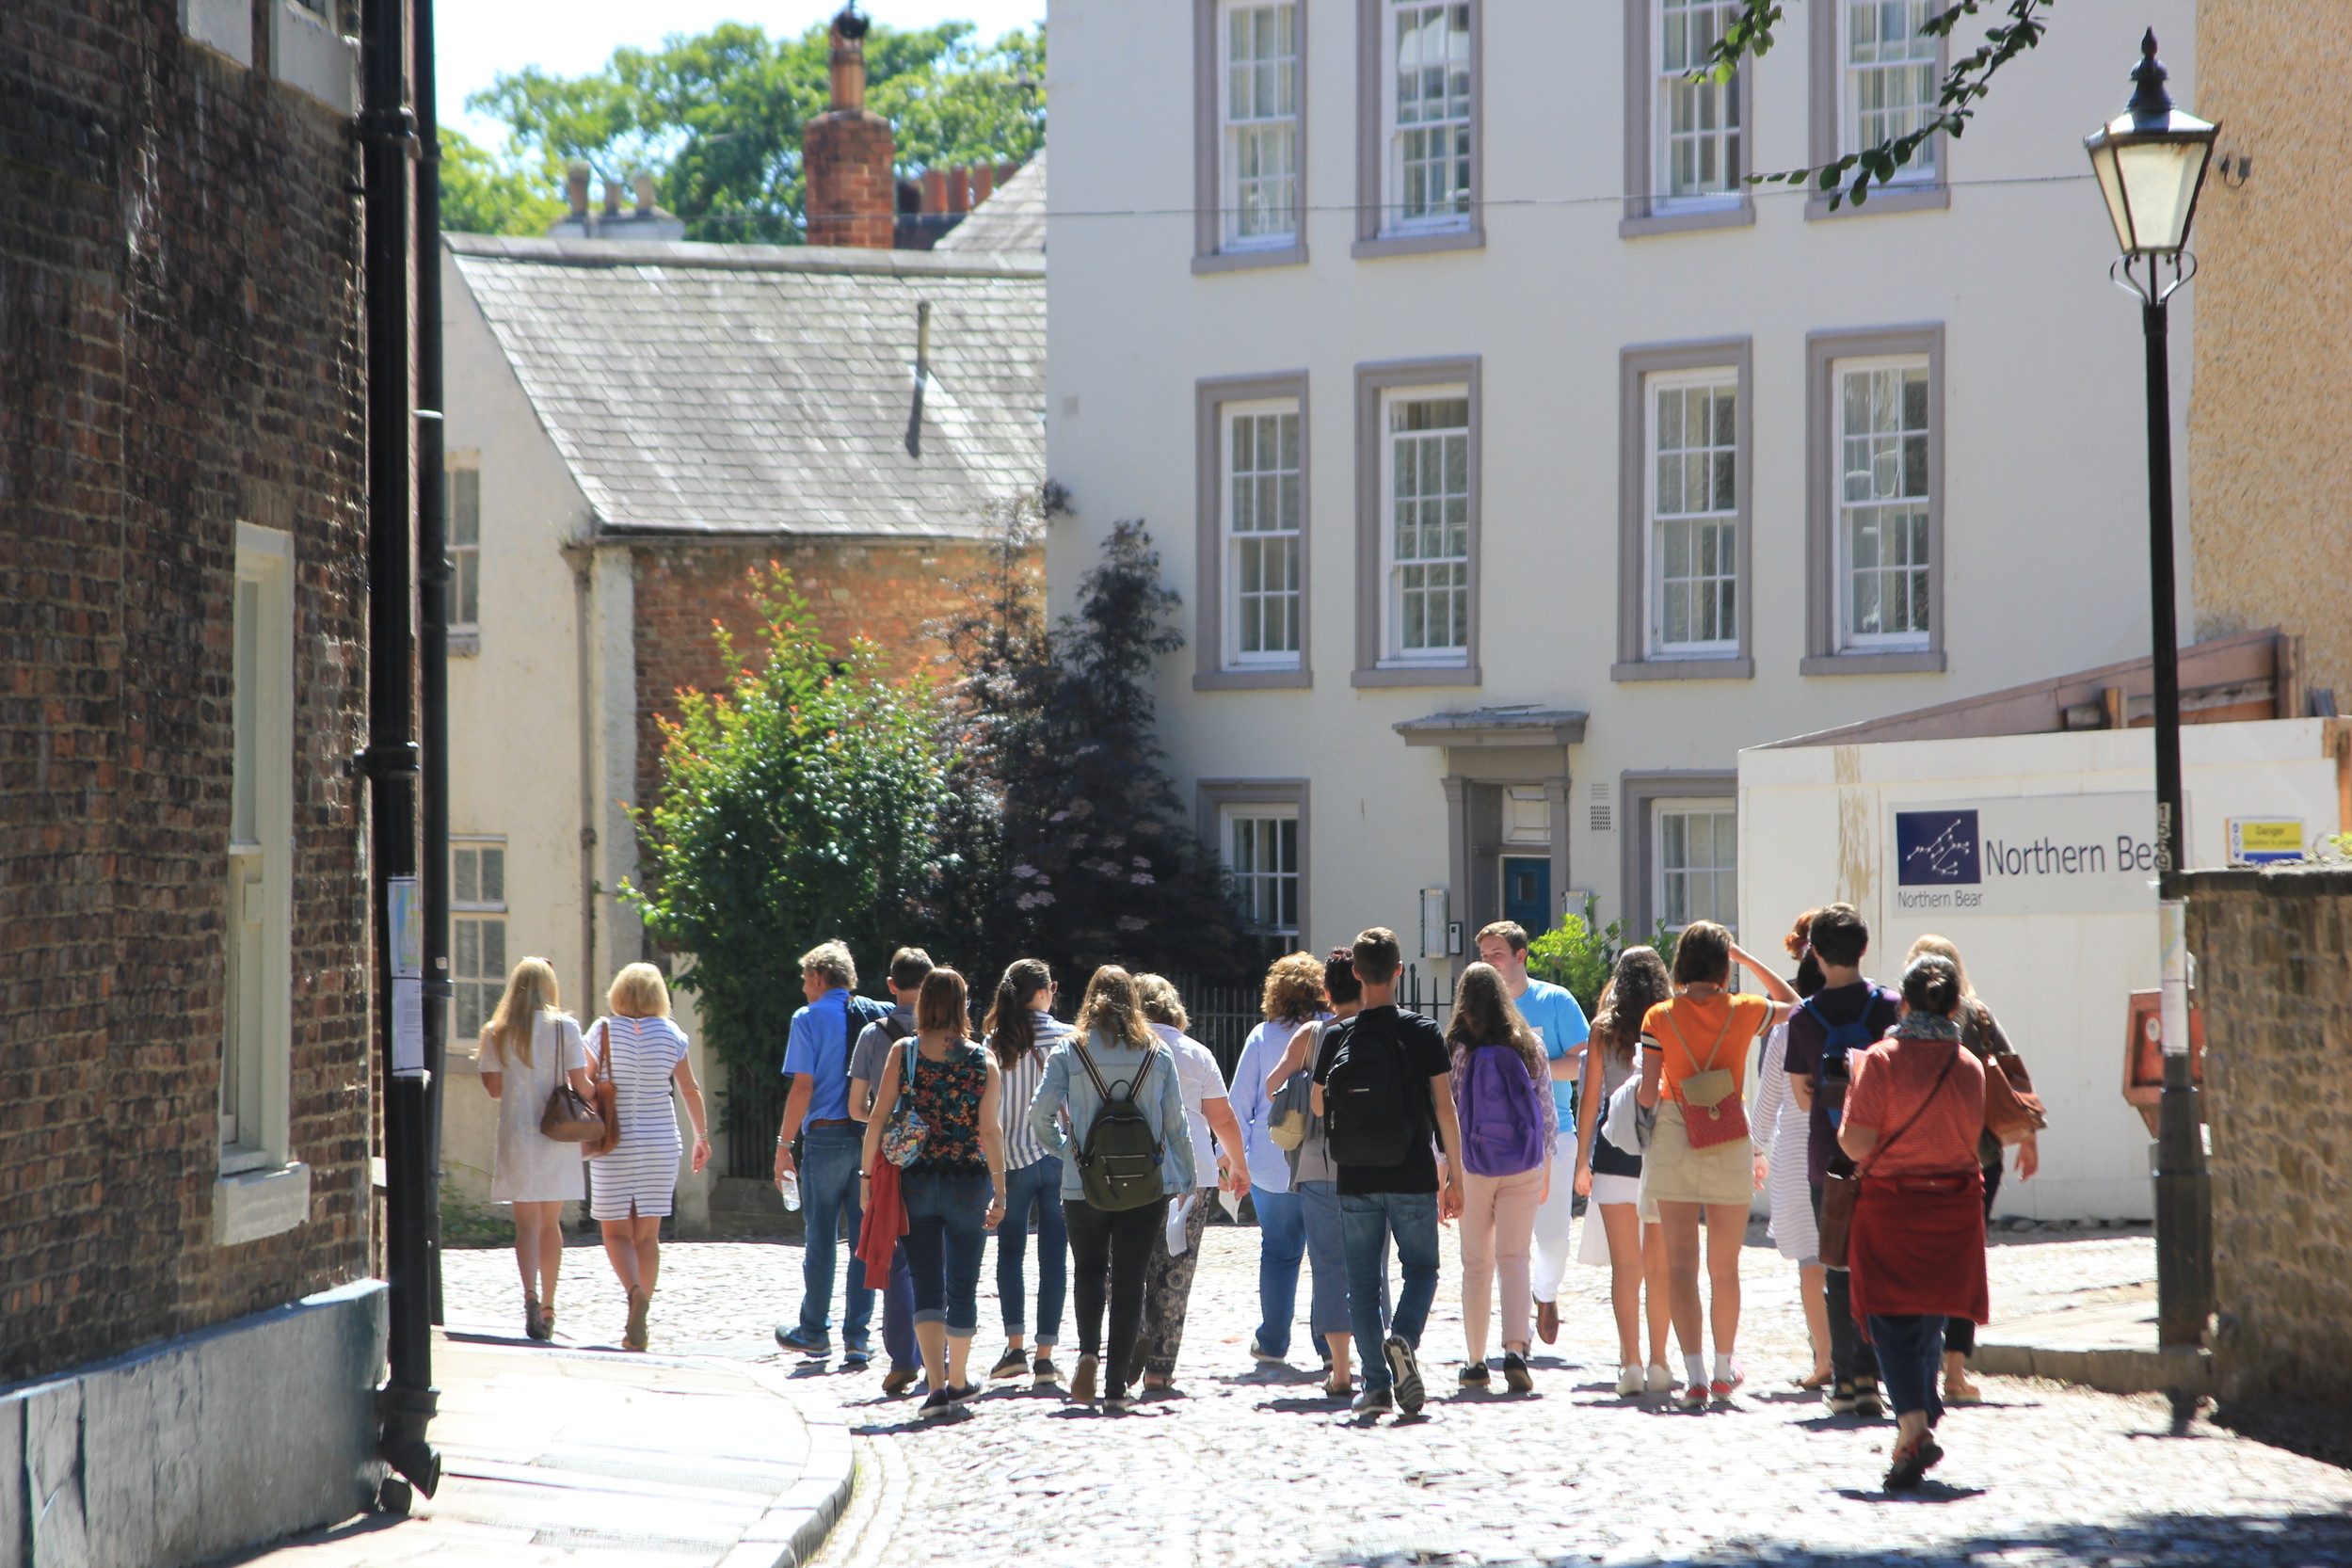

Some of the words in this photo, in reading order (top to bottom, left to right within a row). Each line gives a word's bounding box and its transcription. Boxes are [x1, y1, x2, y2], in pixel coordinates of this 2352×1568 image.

[1986, 838, 2104, 875] Northern
[1897, 890, 1950, 908] Northern
[1955, 889, 1983, 907] Bear
